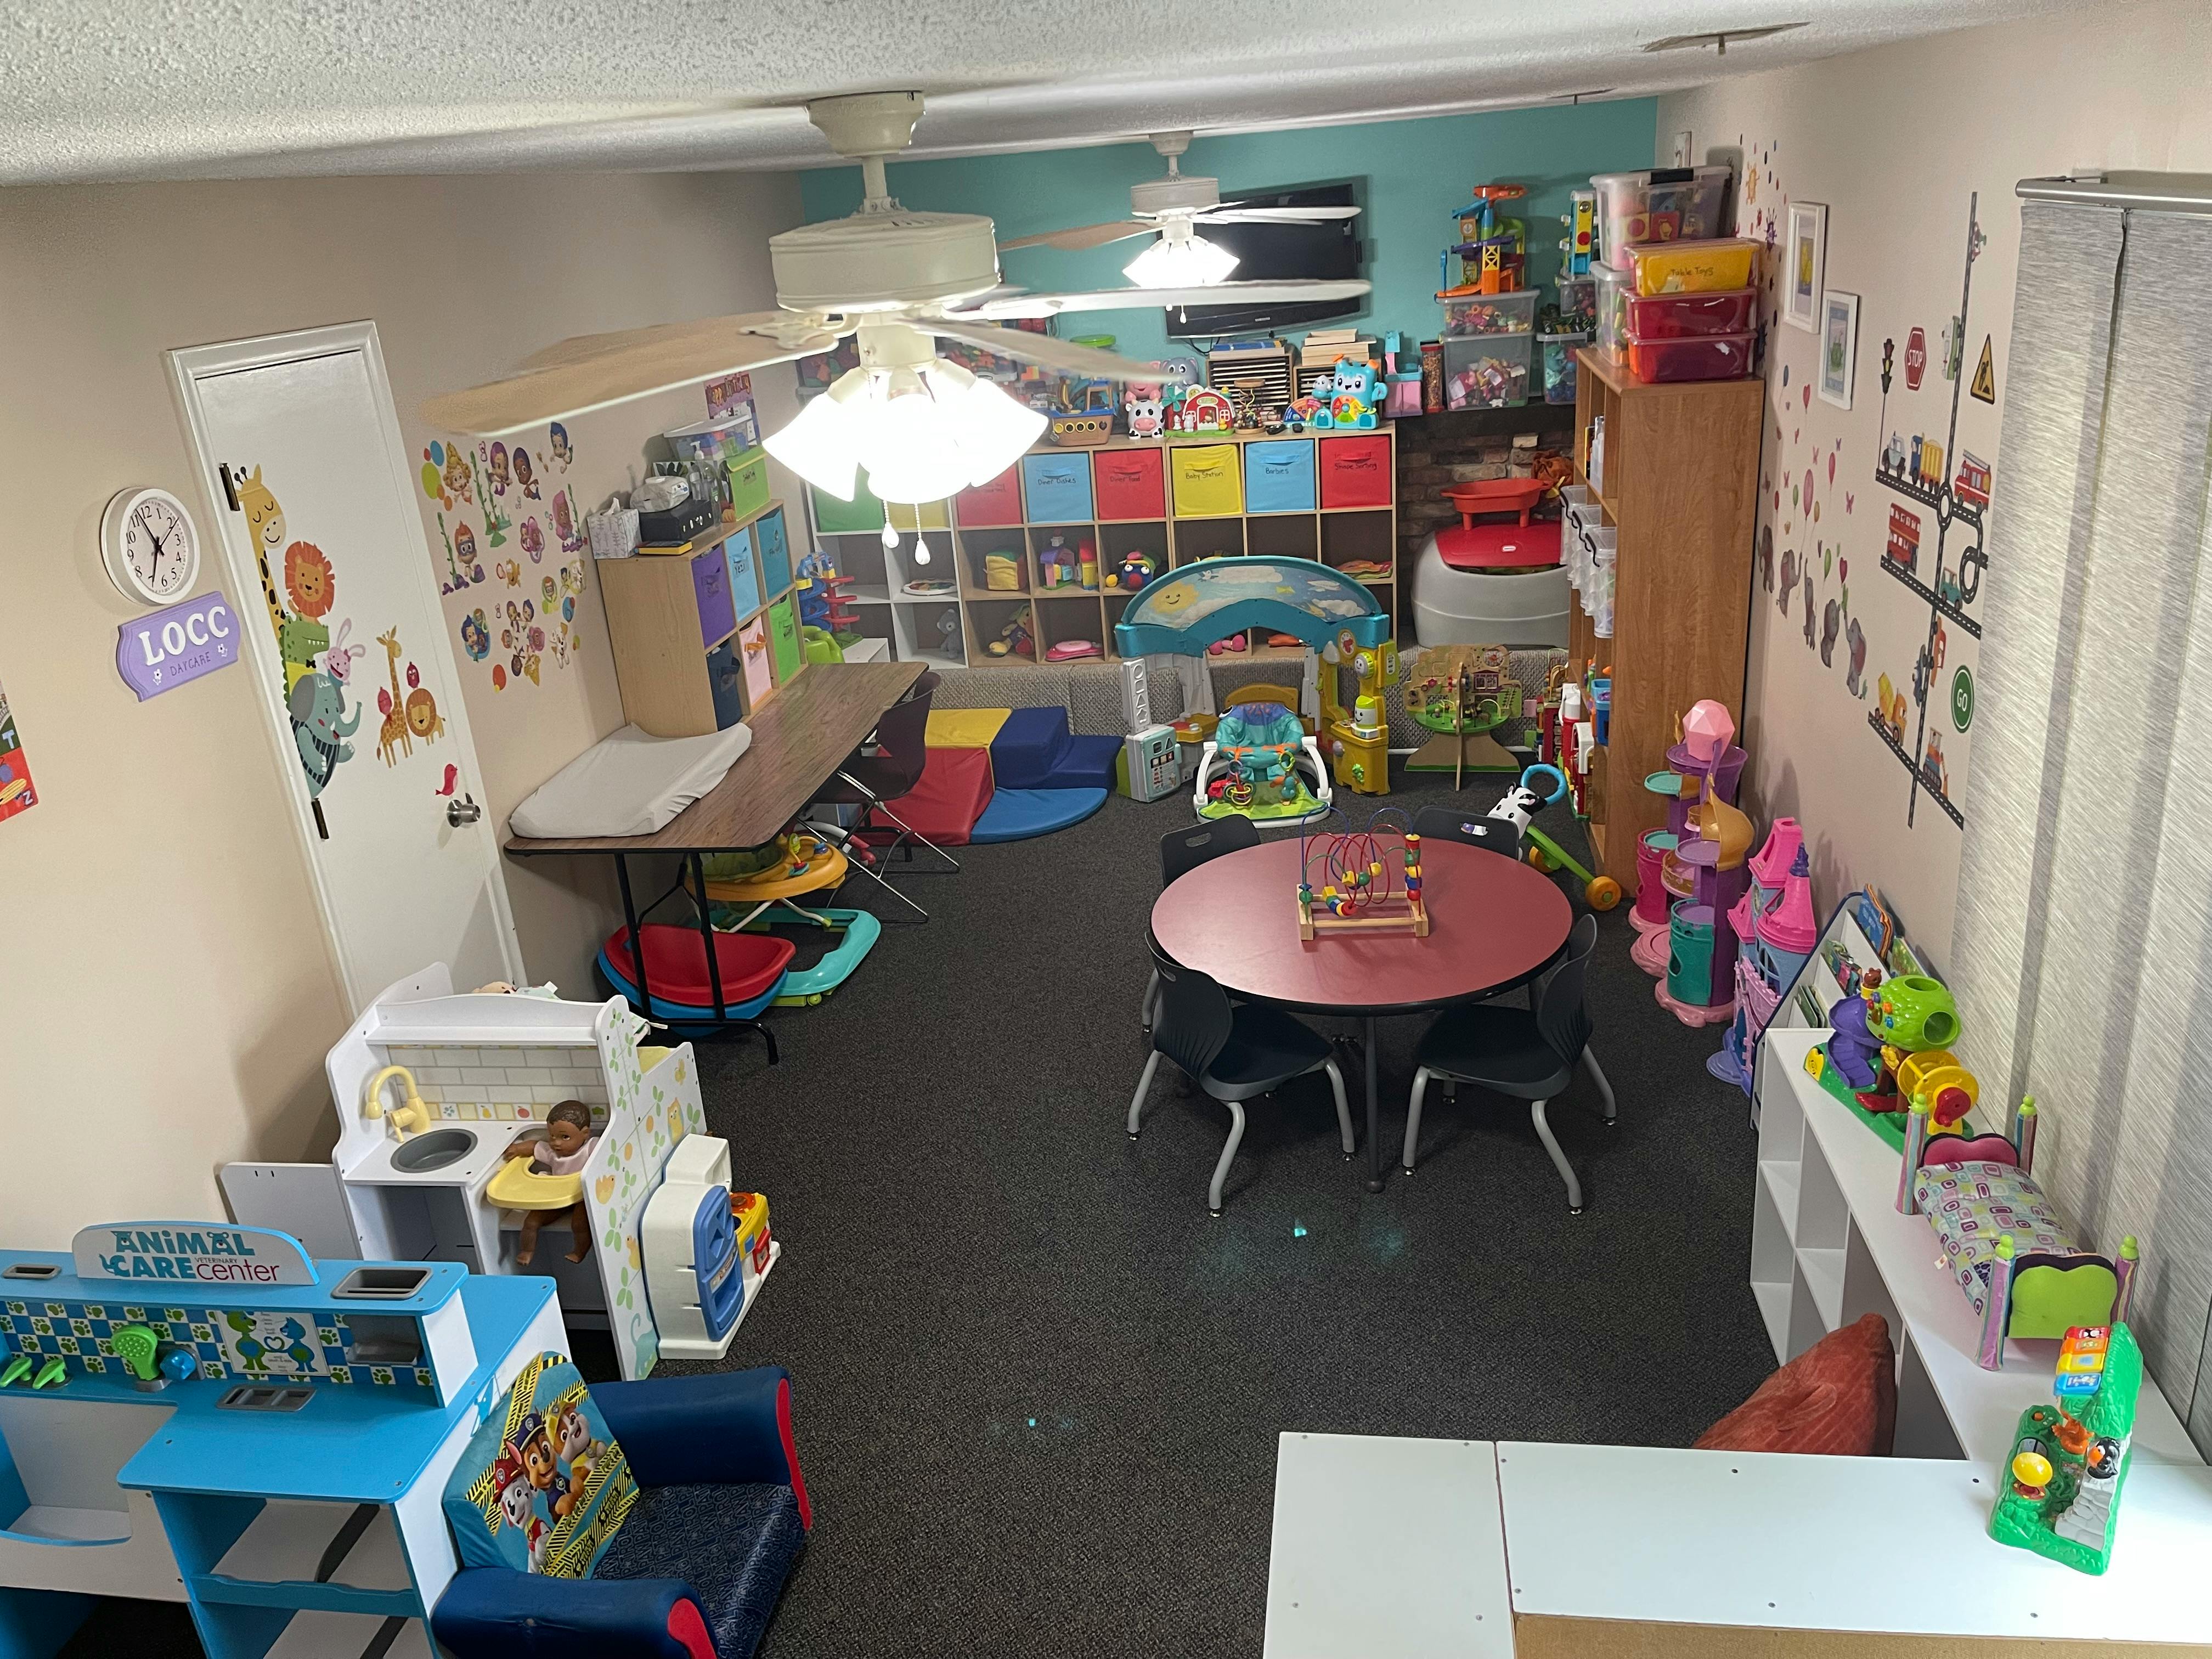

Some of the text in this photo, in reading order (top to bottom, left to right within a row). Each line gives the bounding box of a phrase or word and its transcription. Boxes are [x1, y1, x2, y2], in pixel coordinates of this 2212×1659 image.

[1671, 267, 1714, 276] Table Toys
[1908, 349, 1923, 368] STOP
[1186, 472, 1201, 481] Baby
[140, 505, 153, 519] 12
[156, 507, 162, 520] 1
[166, 517, 174, 529] 2
[174, 534, 181, 546] 3
[127, 549, 134, 561] 9
[176, 551, 182, 563] 4
[135, 565, 143, 577] 8
[171, 567, 177, 580] 5
[161, 574, 168, 587] 6
[138, 606, 229, 666] LOCC
[170, 651, 211, 676] DAYCARE
[1956, 689, 1968, 712] GO
[2, 729, 15, 749] T
[105, 1254, 197, 1279] CARE
[194, 1256, 238, 1265] VETERINARY
[196, 1259, 280, 1282] center
